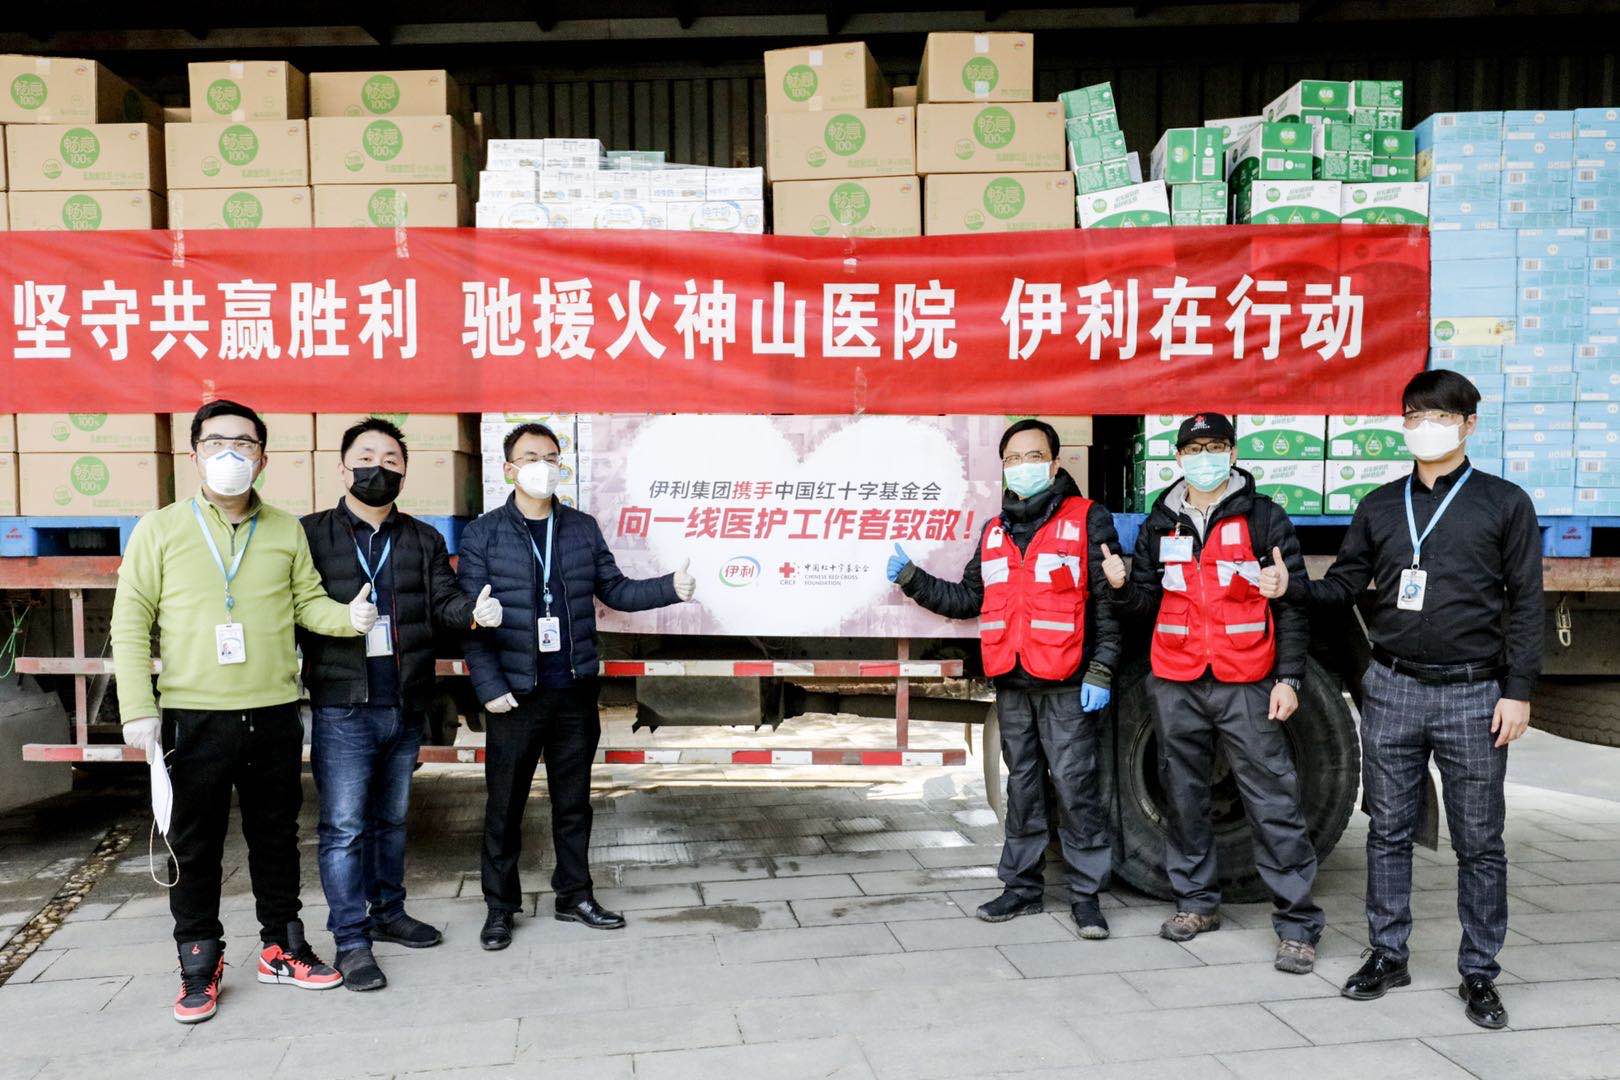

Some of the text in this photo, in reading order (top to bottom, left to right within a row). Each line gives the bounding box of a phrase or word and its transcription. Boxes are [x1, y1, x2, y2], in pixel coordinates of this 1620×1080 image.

[14, 274, 1365, 362] 坚守共赢胜利 驰援火神山医院 伊利在行动
[648, 480, 942, 501] 伊利集团携手中国红十字基金会
[725, 565, 755, 578] 伊利
